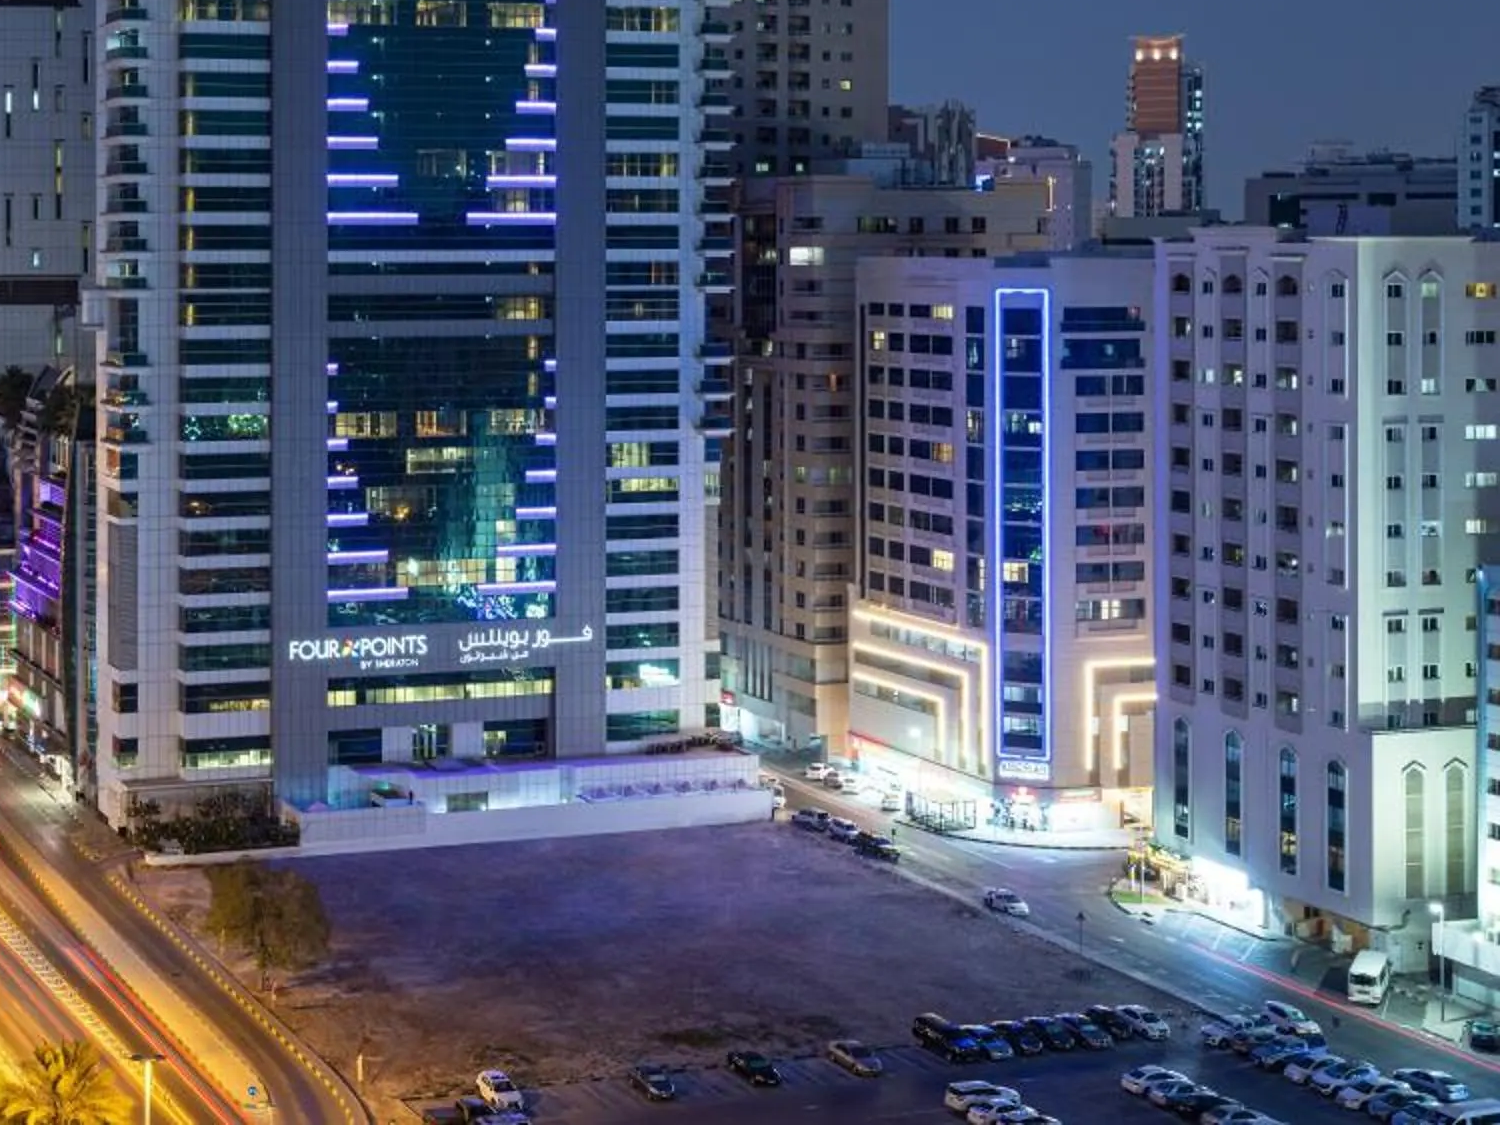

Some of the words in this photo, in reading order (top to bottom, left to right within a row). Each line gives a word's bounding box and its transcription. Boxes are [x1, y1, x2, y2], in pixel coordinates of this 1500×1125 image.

[289, 639, 340, 661] FOUR
[360, 634, 428, 657] POINTS
[360, 659, 373, 670] BY
